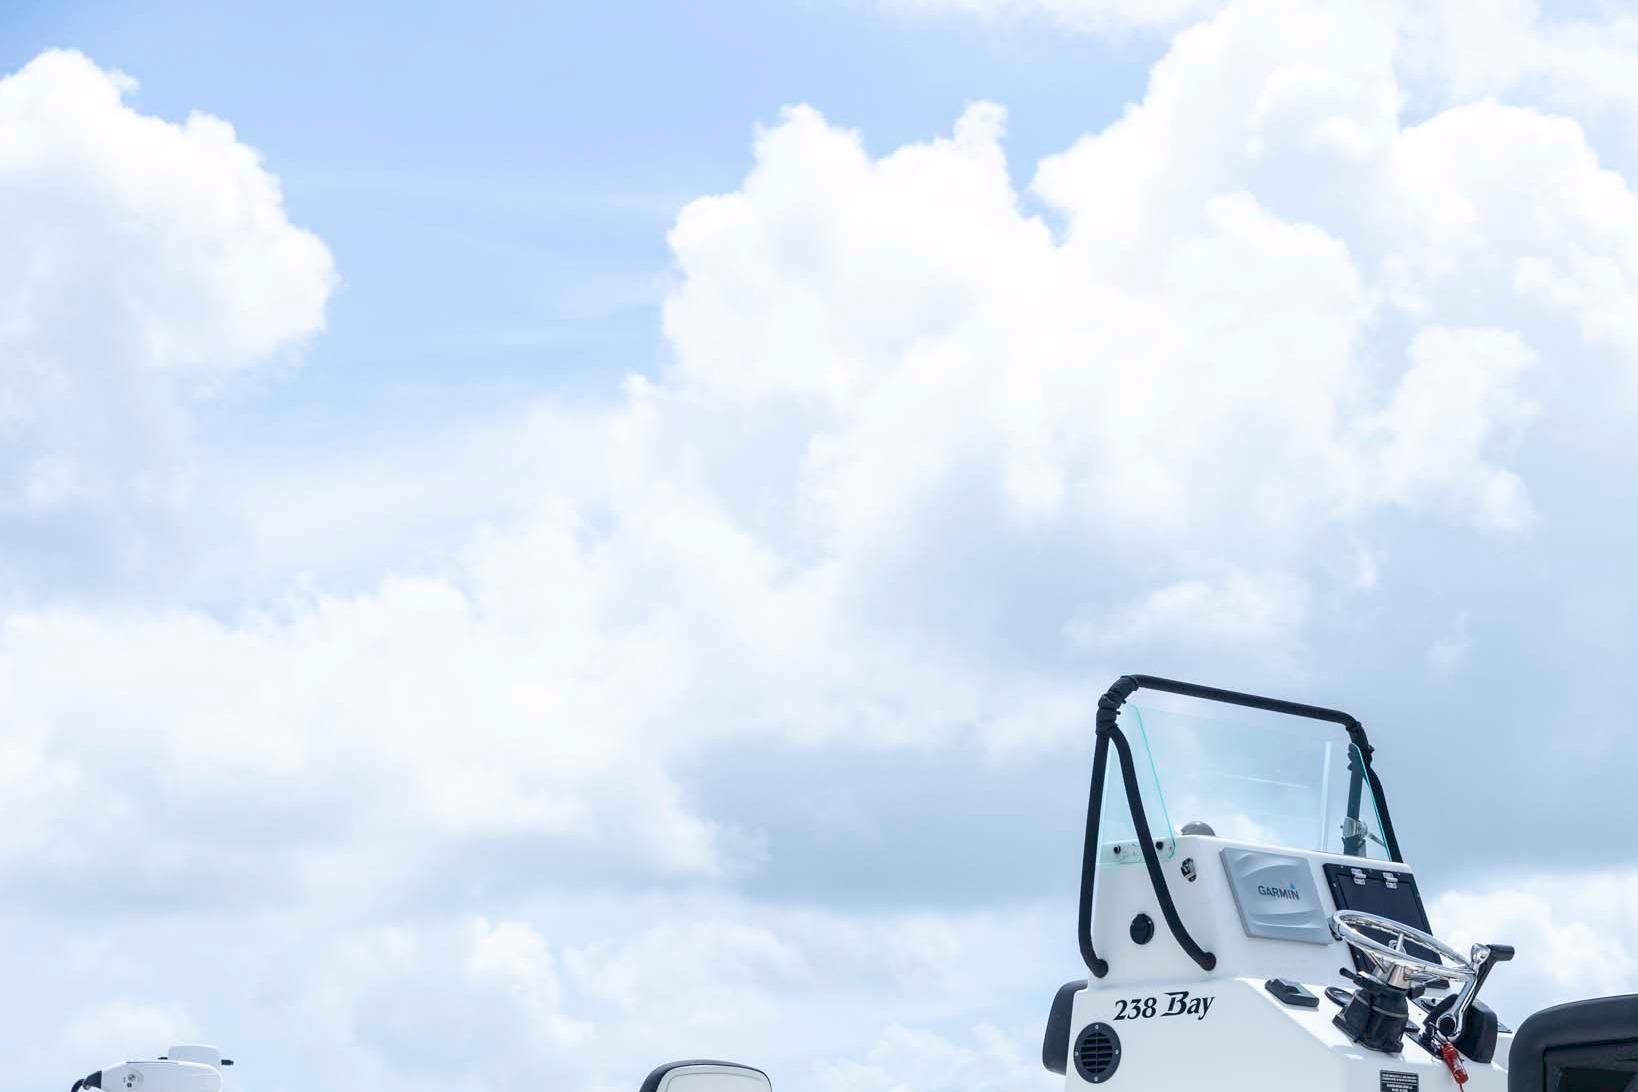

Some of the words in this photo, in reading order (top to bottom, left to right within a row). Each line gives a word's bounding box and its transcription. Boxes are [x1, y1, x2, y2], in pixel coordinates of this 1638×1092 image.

[1257, 884, 1300, 901] GARMIN
[1113, 997, 1157, 1021] 238
[1160, 991, 1216, 1020] Bay
